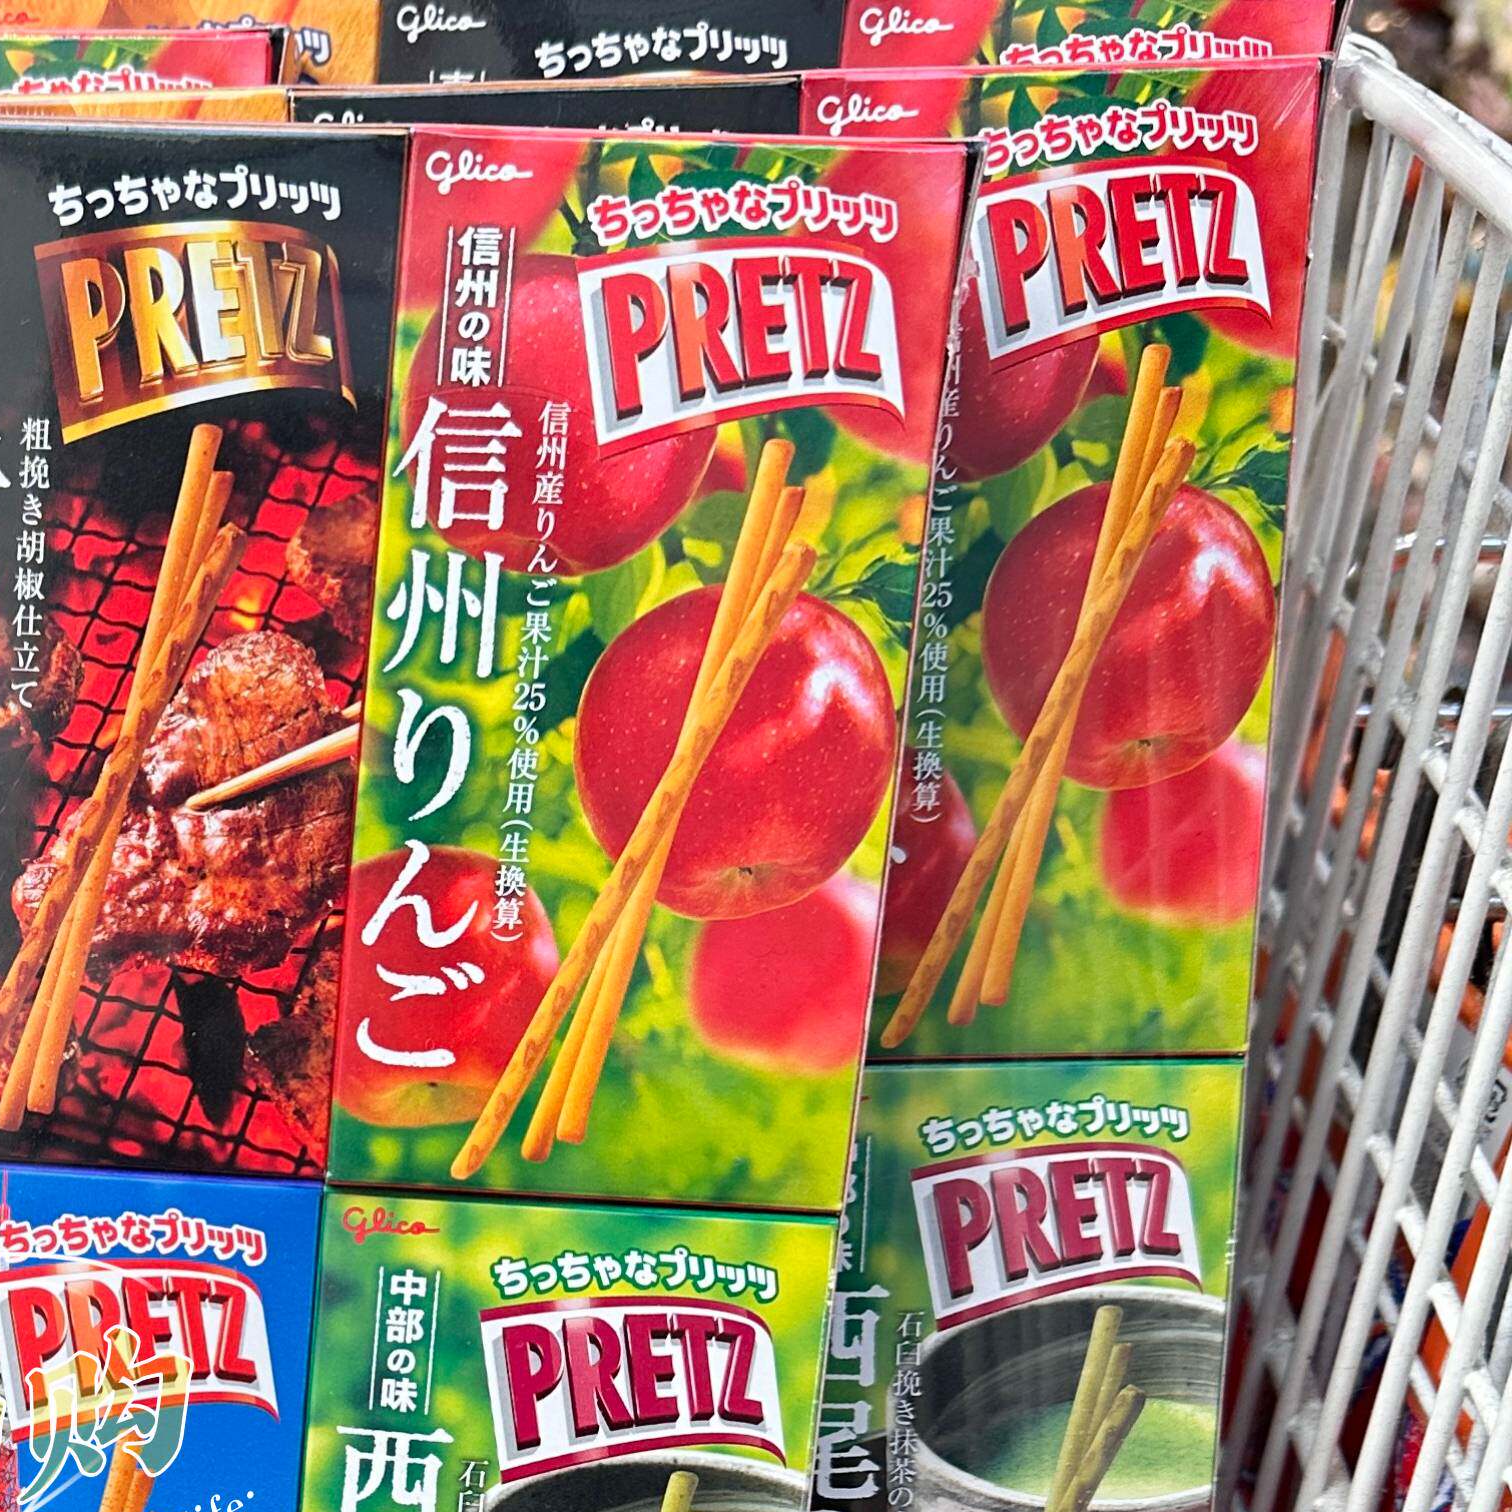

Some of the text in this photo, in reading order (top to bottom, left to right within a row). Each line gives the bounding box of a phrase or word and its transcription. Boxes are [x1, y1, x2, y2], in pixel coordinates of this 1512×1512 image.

[397, 5, 487, 42] Glico
[534, 22, 788, 78] ちっちゃなプリッツ
[859, 8, 954, 46] Glico
[817, 96, 919, 136] Glico
[984, 100, 1259, 176] ちっちゃなプリッツ
[49, 165, 343, 226] ちっちゃなプリッツ
[425, 151, 533, 194] Glico
[589, 176, 899, 244] ちっちゃなプリッツ
[988, 174, 1252, 336] PRETZ
[60, 240, 335, 404] PRETZ
[450, 226, 502, 387] 信州の味
[602, 256, 884, 422] PRETZ
[11, 418, 53, 709] 粗挽き胡椒仕立て
[355, 397, 522, 1068] 信州りんご
[923, 1096, 1188, 1153] ちっちゃなプリッツ
[342, 1207, 439, 1243] Glico
[933, 1158, 1183, 1300] PRETZ
[495, 1247, 777, 1298] ちっちゃなプリッツ
[9, 1277, 260, 1412] PRETZ
[380, 1270, 426, 1413] 中部の味
[502, 1314, 765, 1452] PRETZ
